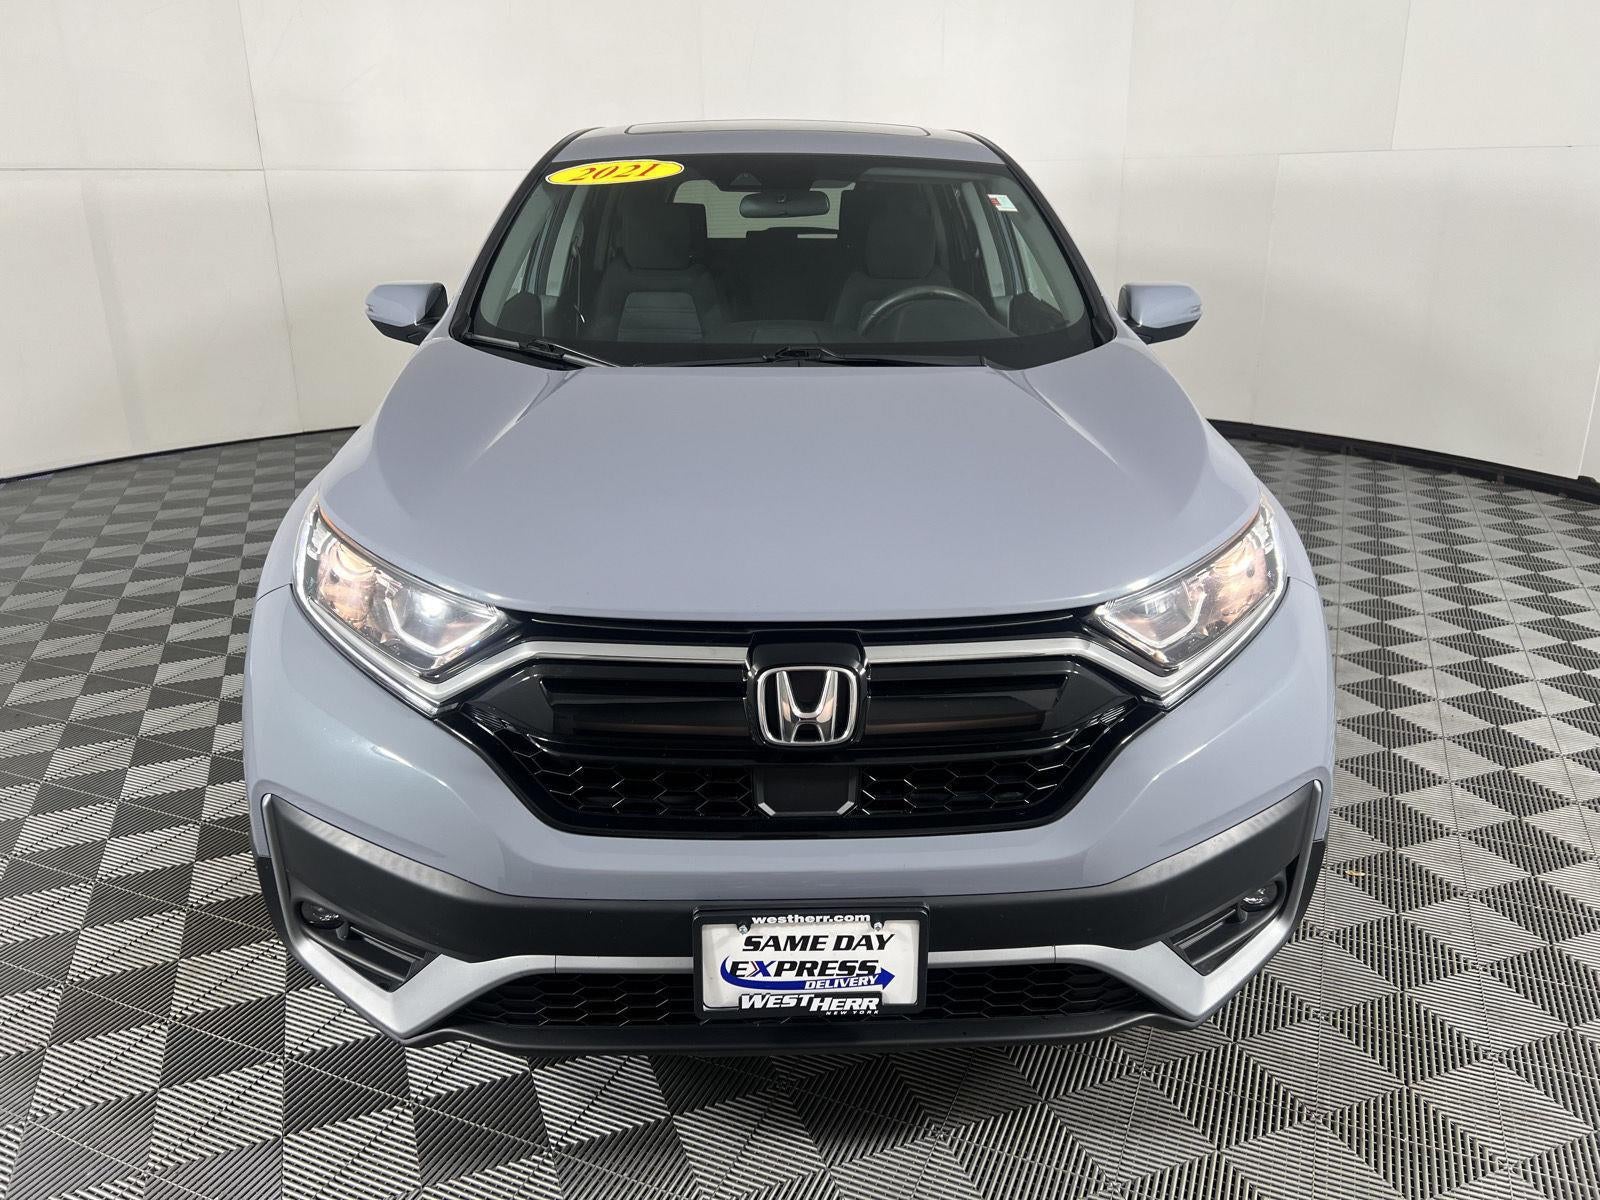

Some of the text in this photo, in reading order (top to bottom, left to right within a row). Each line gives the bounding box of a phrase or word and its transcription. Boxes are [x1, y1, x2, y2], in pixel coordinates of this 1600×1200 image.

[569, 163, 660, 182] 2021
[751, 914, 871, 924] westherr.com
[742, 933, 896, 952] SAME DAY
[730, 959, 879, 978] EXPRESS
[804, 975, 879, 990] DELIVERY
